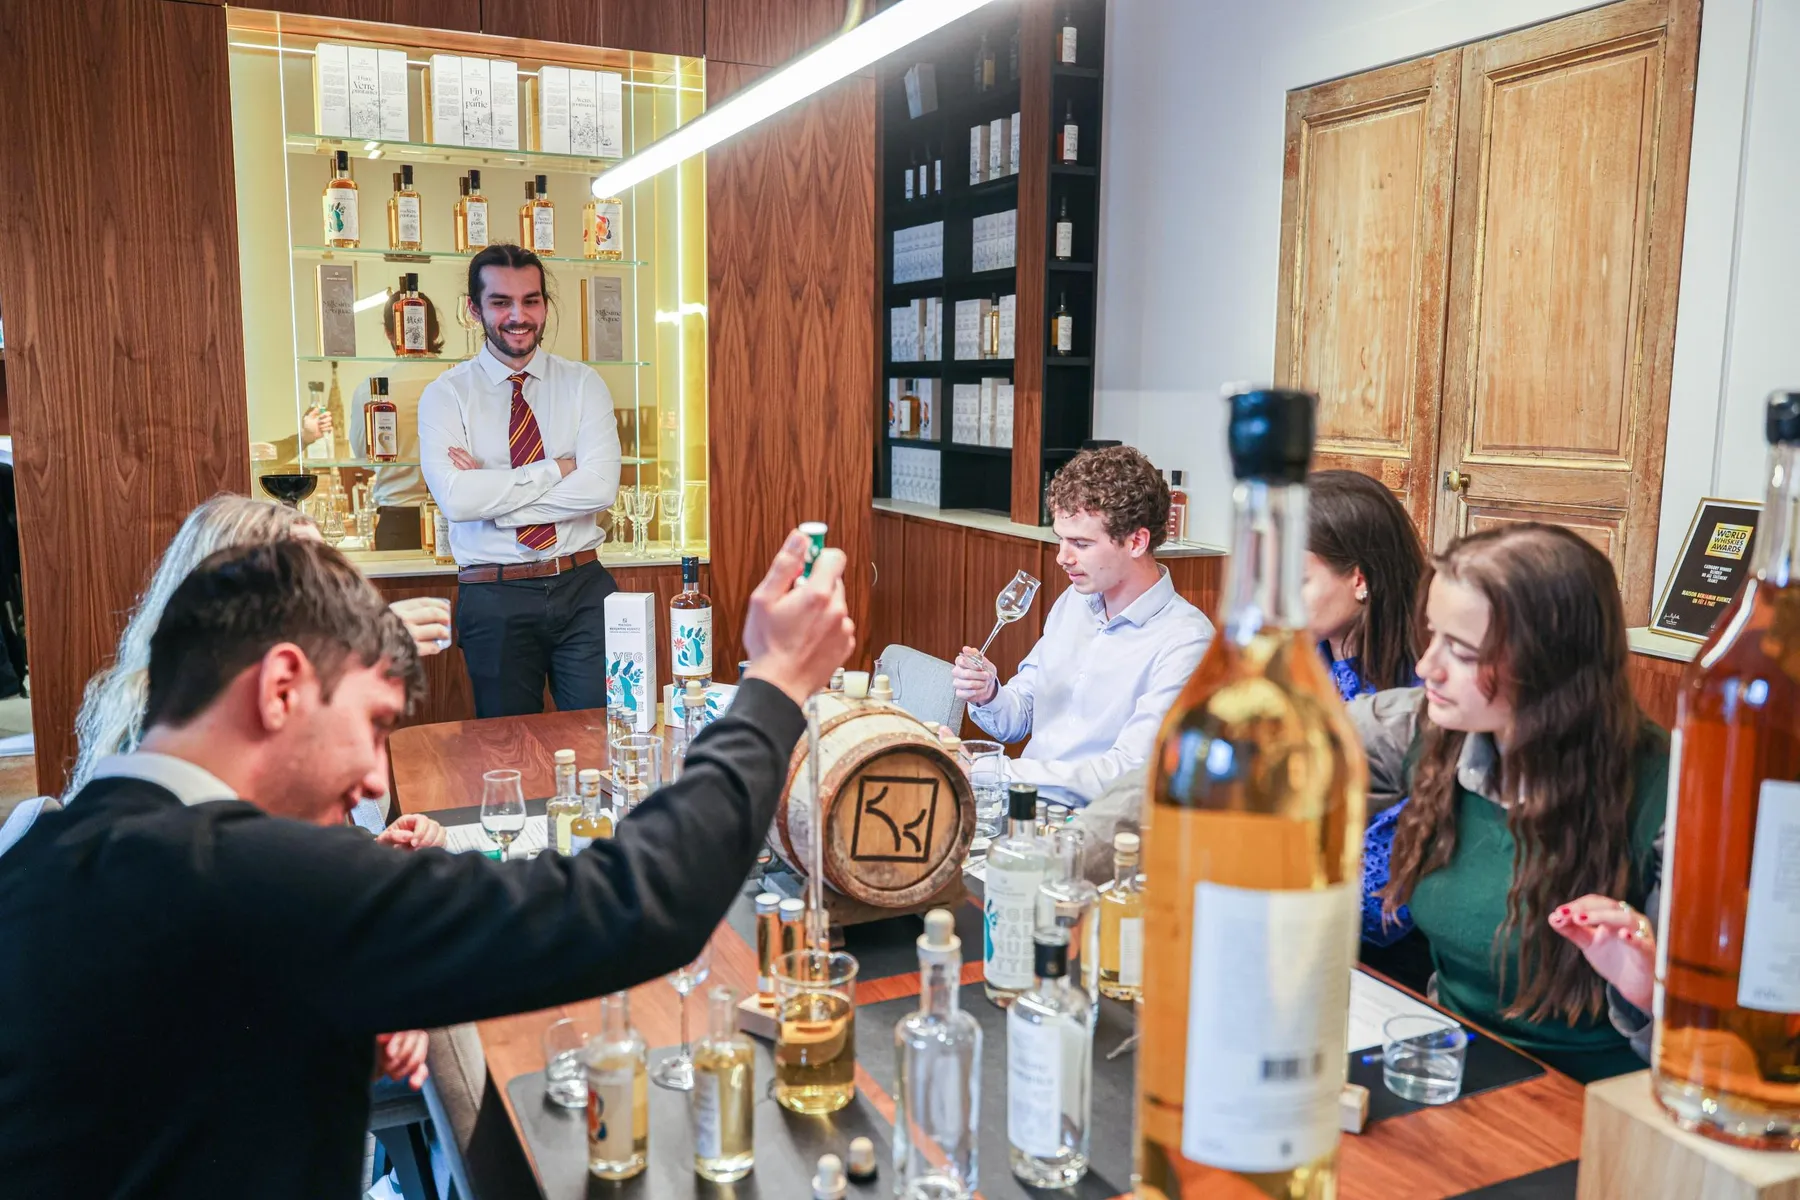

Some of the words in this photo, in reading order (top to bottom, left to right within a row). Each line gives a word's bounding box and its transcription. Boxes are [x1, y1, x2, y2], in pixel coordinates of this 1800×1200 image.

[353, 81, 376, 91] Verre
[469, 87, 483, 96] Fin
[465, 101, 489, 109] partie
[1717, 529, 1747, 540] WORLD
[1714, 537, 1744, 546] WHISKIES
[1711, 543, 1742, 553] AWARDS
[613, 651, 644, 663] VEG
[613, 684, 644, 697] MS
